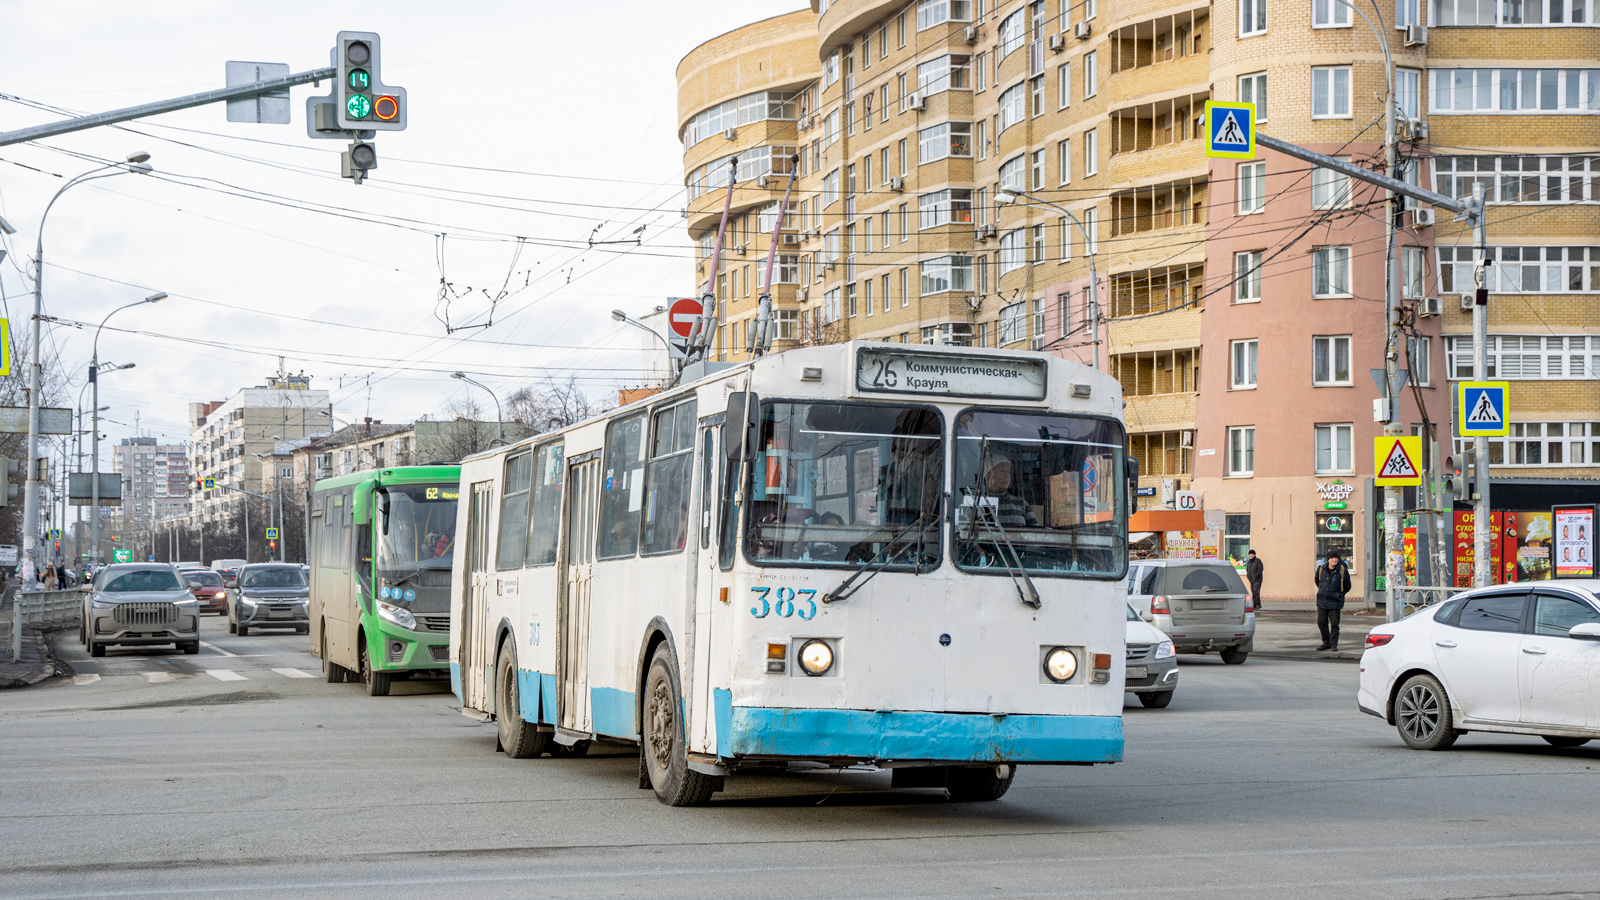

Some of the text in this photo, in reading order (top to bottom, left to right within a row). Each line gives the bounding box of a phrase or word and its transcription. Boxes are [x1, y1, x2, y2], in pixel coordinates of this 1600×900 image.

[352, 73, 368, 87] 14
[873, 358, 898, 388] 26
[906, 361, 1022, 380] Коммунистическая-
[906, 376, 949, 389] Крауля
[426, 487, 439, 500] 62
[1462, 513, 1495, 523] ОРИ
[1168, 540, 1198, 548] ФРУКТЫ
[1170, 551, 1196, 559] ОВОЩИ
[750, 586, 818, 620] 383
